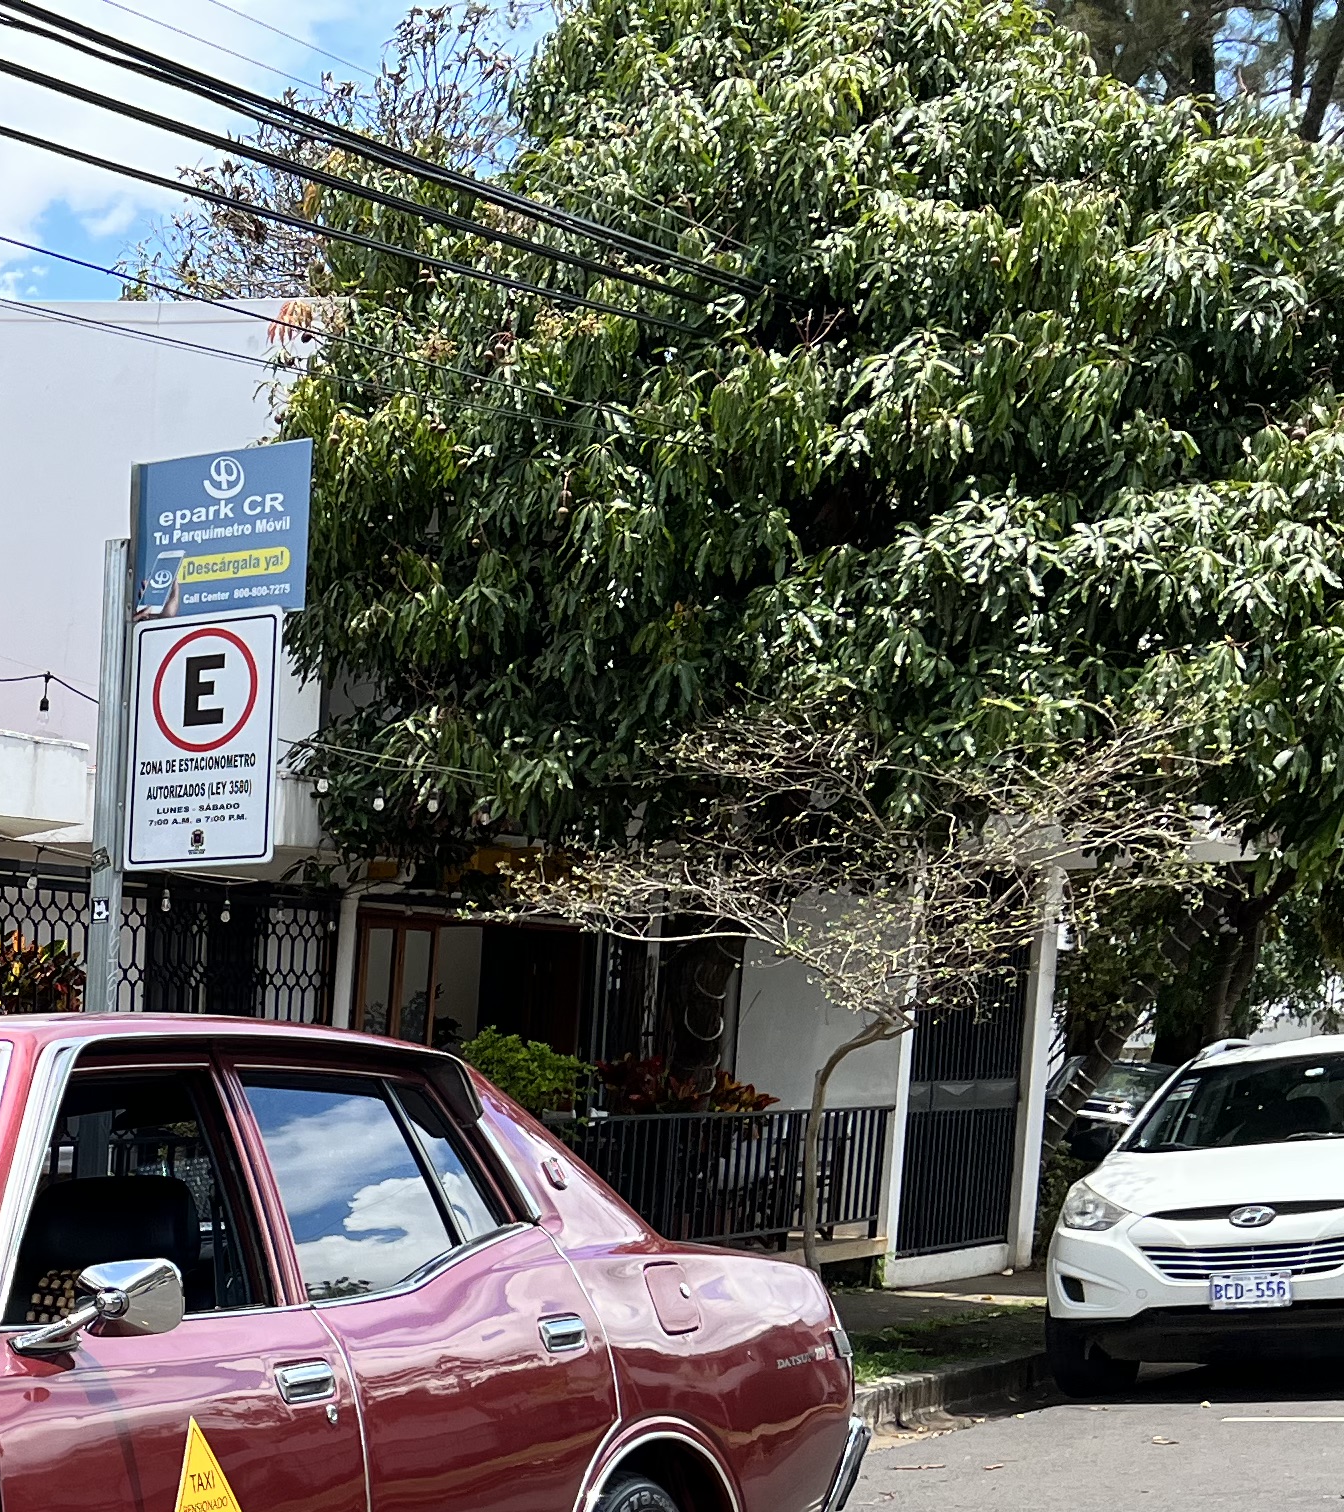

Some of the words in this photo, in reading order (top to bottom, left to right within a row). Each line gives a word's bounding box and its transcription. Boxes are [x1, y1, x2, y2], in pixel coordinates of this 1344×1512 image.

[159, 500, 234, 529] epark
[243, 492, 284, 516] CR
[154, 531, 170, 546] Tu
[173, 524, 252, 544] Parquímetro
[255, 516, 291, 533] Móvil
[182, 554, 260, 581] ¡Descárgala
[264, 550, 285, 571] ya!
[183, 593, 200, 604] Call
[201, 591, 230, 602] Center
[182, 652, 226, 727] E
[140, 761, 163, 776] ZONA
[165, 759, 177, 773] DE
[178, 753, 256, 773] ESTACIONOMETRO
[146, 783, 206, 800] AUTORIZADOS
[208, 781, 227, 799] (LEY
[156, 806, 190, 815] LUNES
[198, 803, 240, 812] SÁBADO
[148, 819, 169, 827] 7:00
[205, 815, 226, 823] 7:00
[1214, 1281, 1285, 1300] BCD-556
[190, 1469, 216, 1493] TAXI
